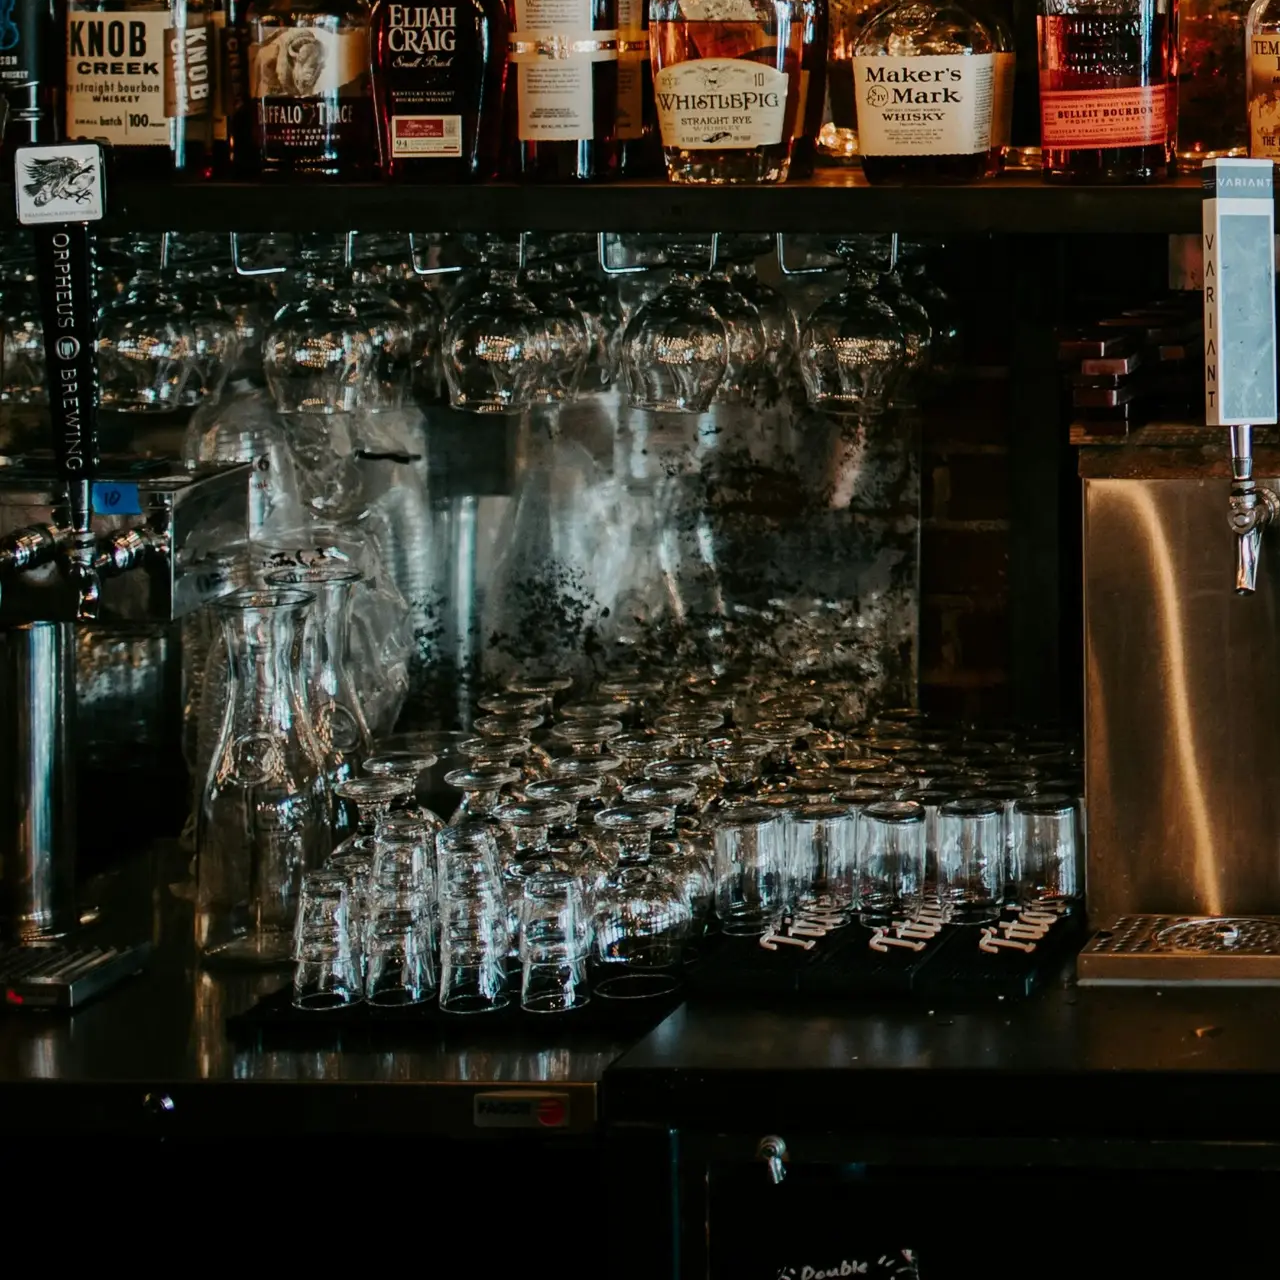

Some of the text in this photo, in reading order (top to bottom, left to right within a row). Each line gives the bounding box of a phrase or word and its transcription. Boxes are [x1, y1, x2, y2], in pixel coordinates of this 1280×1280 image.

[388, 3, 457, 31] ELIJAH
[69, 20, 147, 58] KNOB
[388, 27, 457, 54] CRAIG
[76, 61, 160, 76] CREEK
[185, 27, 209, 101] KNOB
[753, 72, 766, 88] 10
[864, 66, 963, 83] Maker's
[75, 81, 160, 97] straight bourbon
[891, 87, 962, 105] Mark
[92, 95, 141, 103] WHISKEY
[99, 114, 123, 126] batch
[129, 113, 150, 127] 100
[258, 101, 353, 126] BUFFALO TRACE
[680, 115, 753, 126] STRAIGHT RYE
[881, 112, 947, 122] WHISKY
[1057, 105, 1154, 120] BULLEIT BOURBON
[1262, 136, 1276, 147] THE
[1217, 175, 1273, 189] VARIANT
[52, 232, 75, 329] ORPHEUS
[1204, 234, 1216, 408] VARIANT
[60, 368, 83, 471] BREWING
